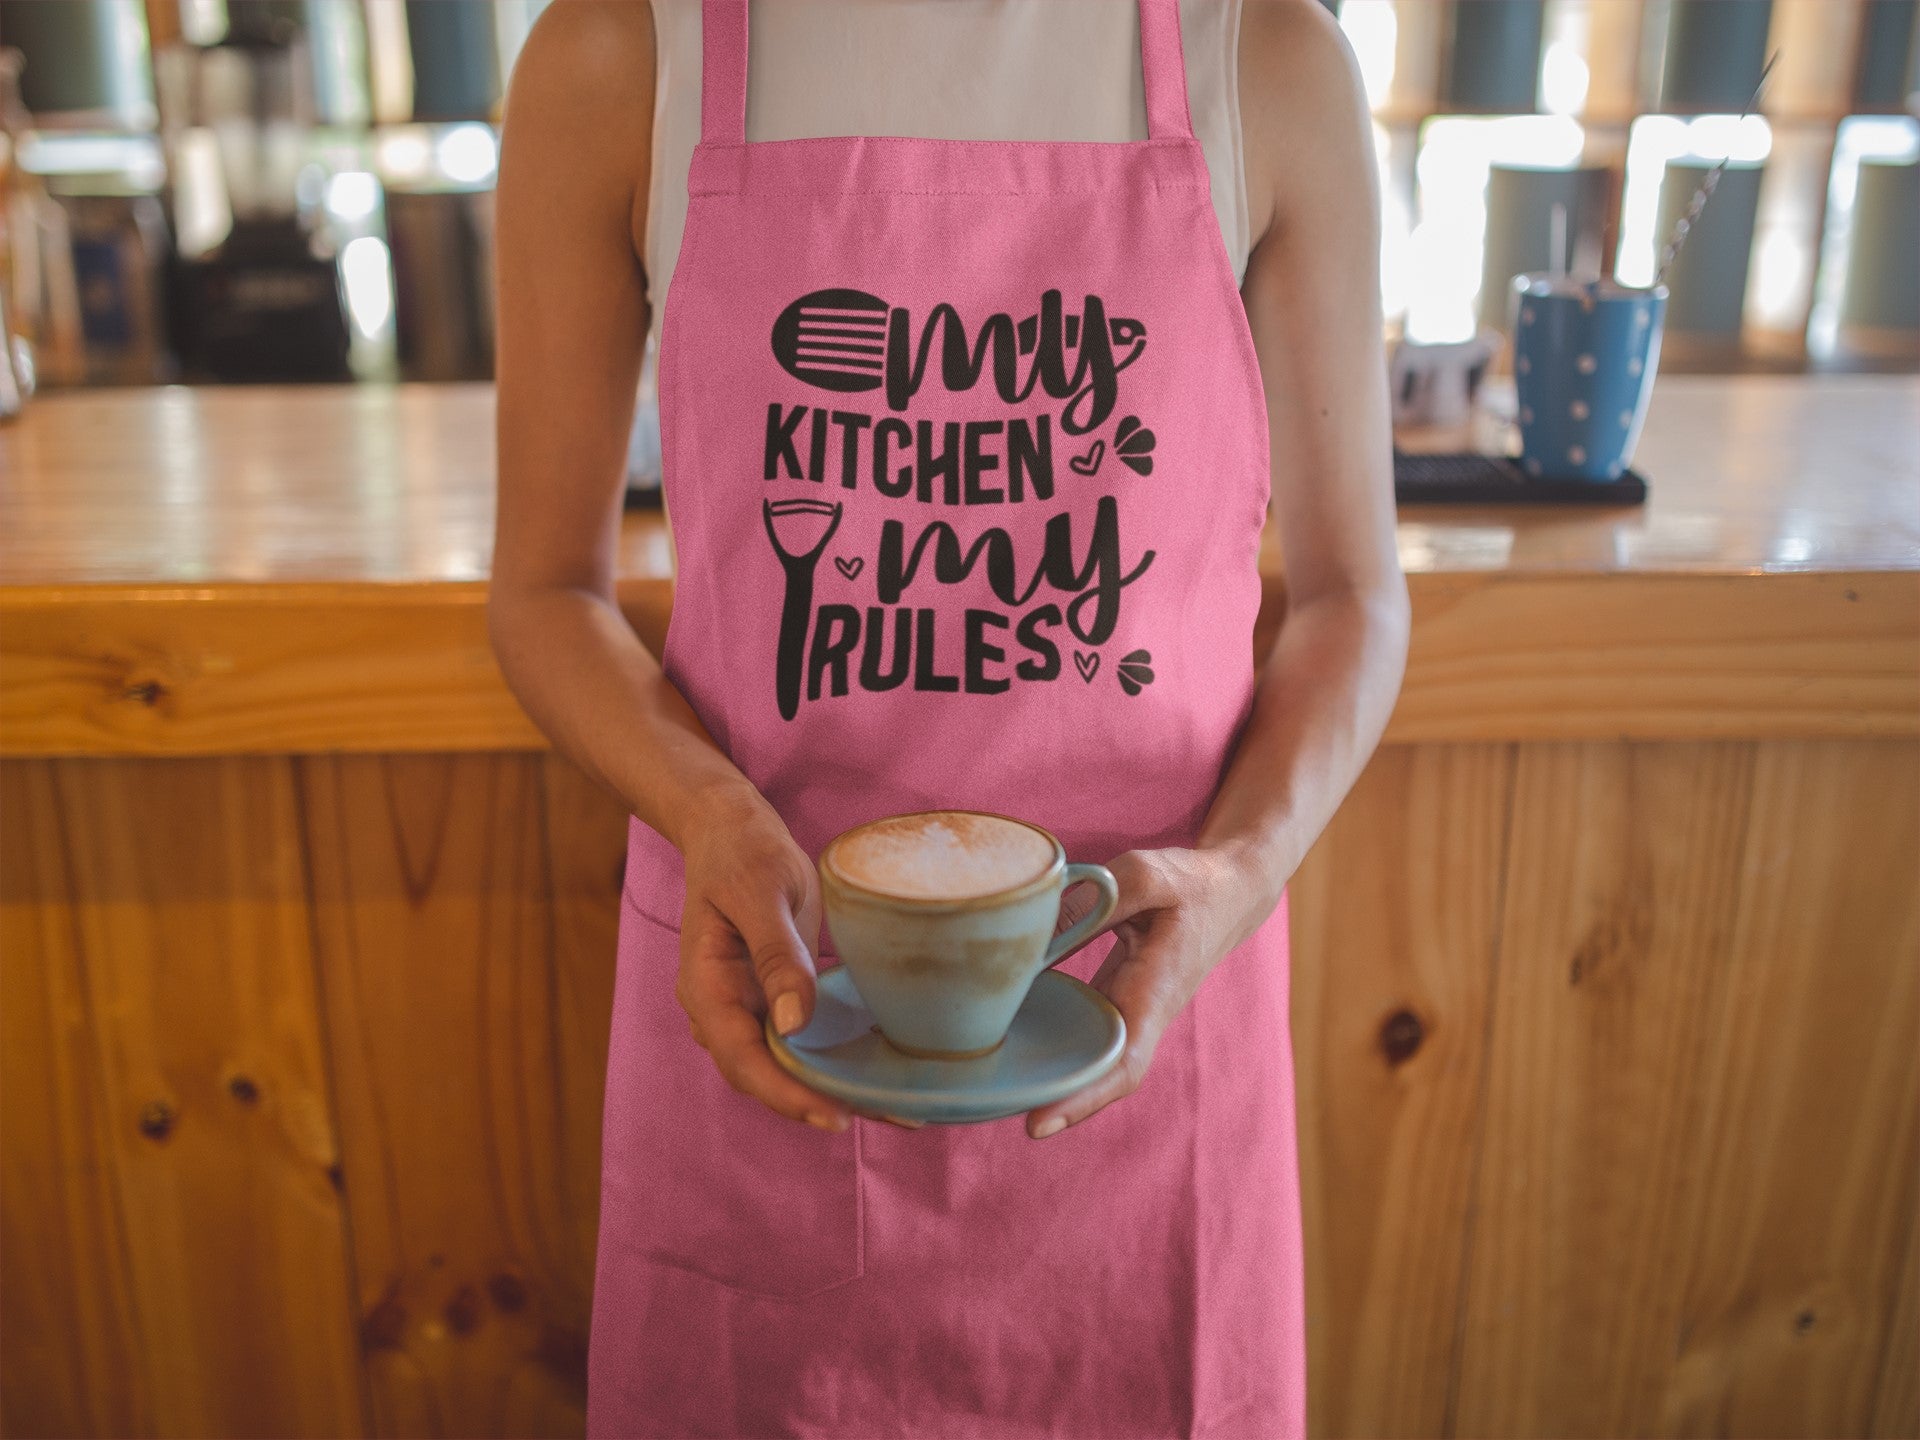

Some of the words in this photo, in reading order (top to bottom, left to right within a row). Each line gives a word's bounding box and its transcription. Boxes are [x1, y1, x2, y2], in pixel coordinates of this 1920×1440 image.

[886, 289, 1118, 435] my
[764, 403, 1054, 505] KITCHEN
[877, 496, 1155, 645] my
[807, 604, 1062, 701] RULES
